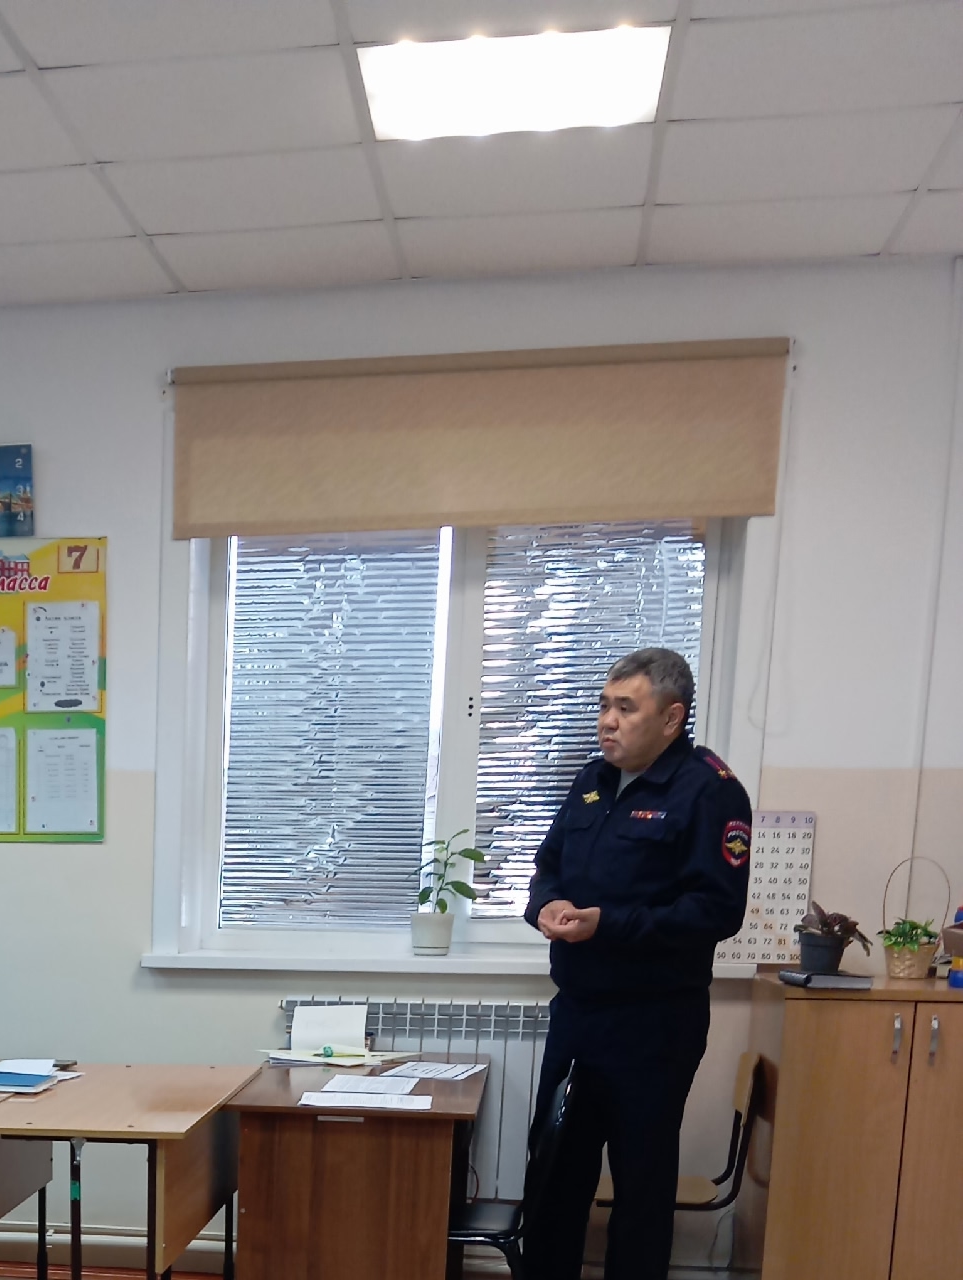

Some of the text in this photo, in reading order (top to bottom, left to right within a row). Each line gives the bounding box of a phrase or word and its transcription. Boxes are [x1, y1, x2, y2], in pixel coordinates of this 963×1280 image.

[15, 459, 22, 468] 2
[17, 512, 23, 521] 4
[67, 545, 88, 570] 7
